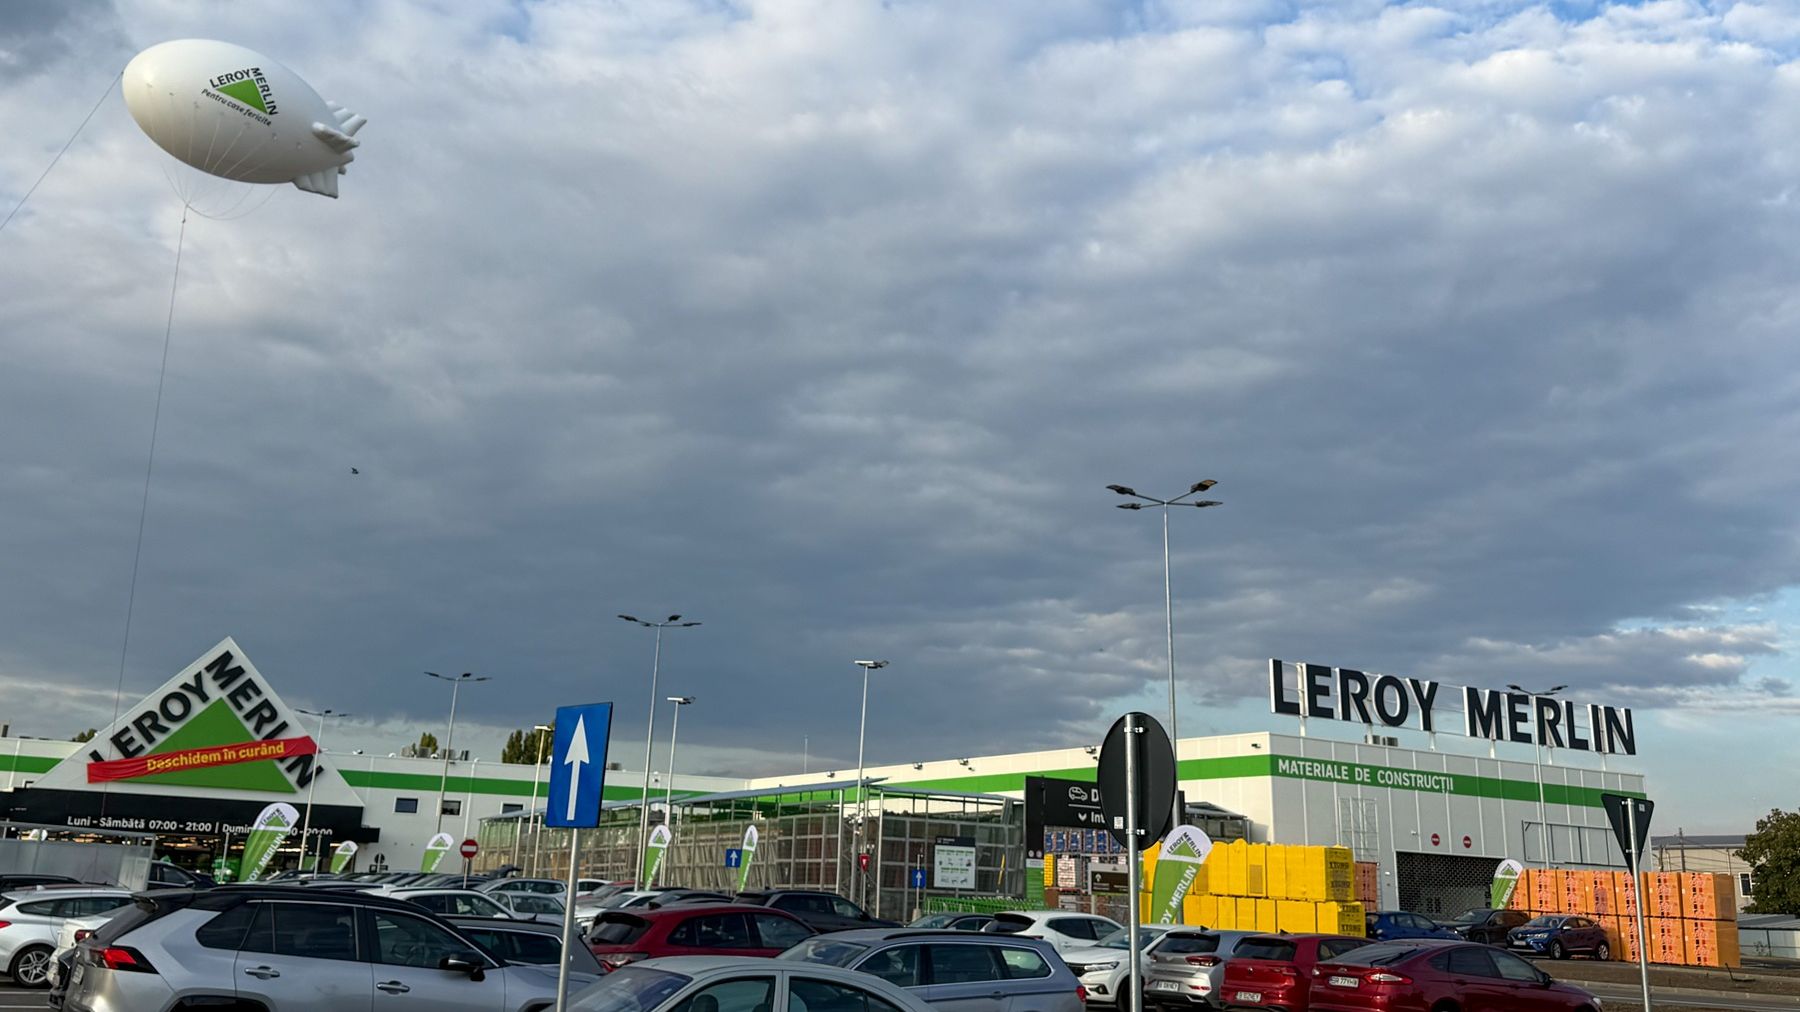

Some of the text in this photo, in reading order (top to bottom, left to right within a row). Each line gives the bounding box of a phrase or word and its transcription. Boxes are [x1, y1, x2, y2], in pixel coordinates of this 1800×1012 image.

[209, 68, 251, 88] LEROY
[250, 67, 279, 116] MERLIN
[201, 88, 272, 127] Pentru case fericite
[89, 670, 210, 763] EROY
[204, 650, 325, 789] MERLN
[1269, 658, 1637, 756] LEROY MERLIN
[147, 742, 285, 771] Deschidem în curând
[1278, 758, 1349, 780] MATERIALE
[1355, 767, 1371, 783] DE
[67, 816, 91, 826] Luni
[99, 817, 145, 829] Sâmbătă
[148, 820, 177, 831] 07:00
[185, 822, 212, 833] 21:00
[222, 824, 253, 834] Dumin
[1167, 835, 1185, 854] LEROY
[1183, 831, 1203, 858] MERLIN
[1168, 864, 1197, 909] MERLIN
